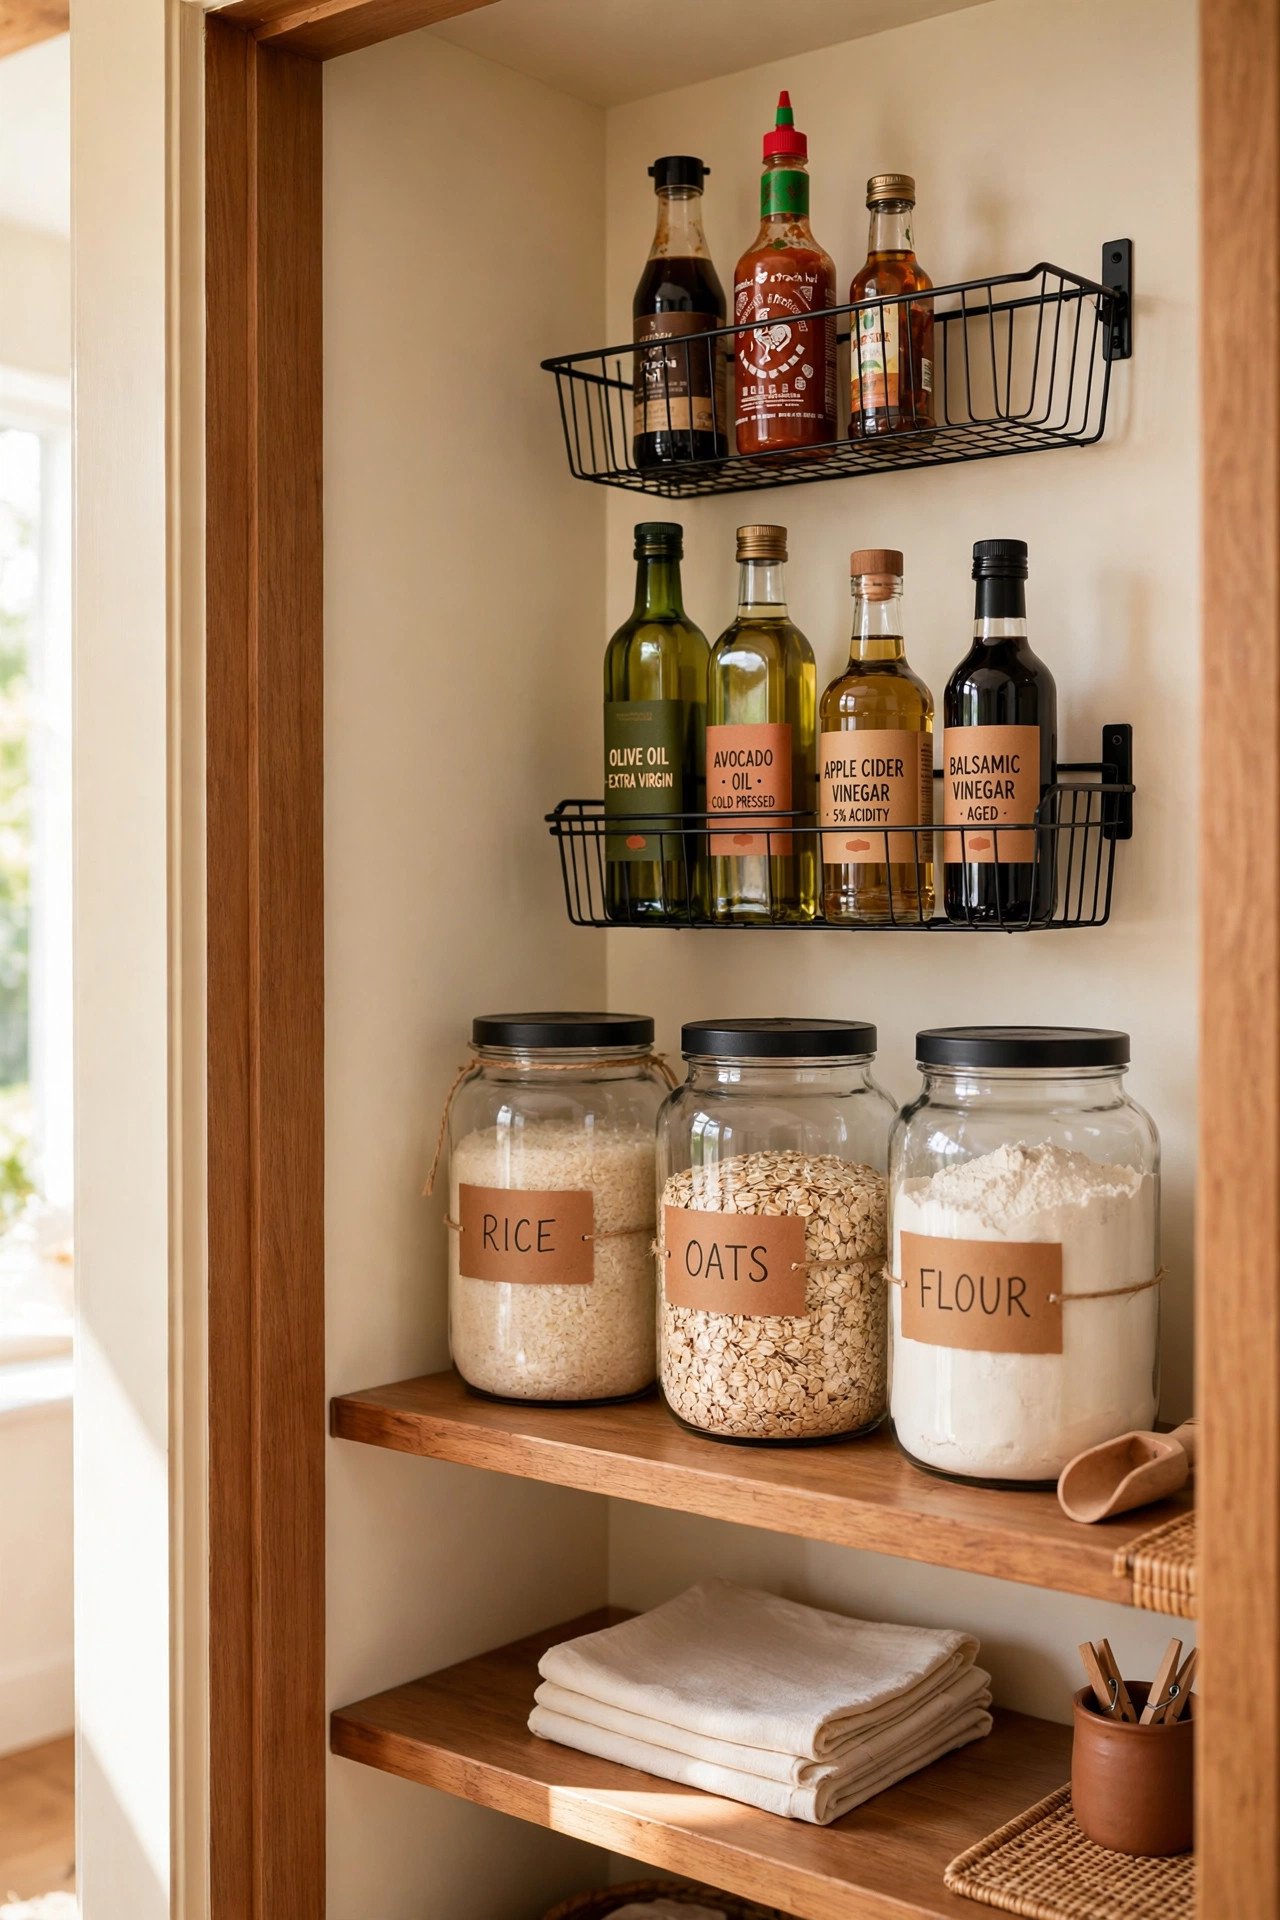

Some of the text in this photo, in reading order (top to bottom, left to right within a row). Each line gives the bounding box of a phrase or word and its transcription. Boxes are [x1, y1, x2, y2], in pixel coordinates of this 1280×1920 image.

[609, 747, 669, 766] OLIVE OIL
[714, 749, 773, 768] AVOCADO
[950, 754, 1020, 775] BALSAMIC
[824, 758, 904, 779] APPLE CIDER
[608, 772, 673, 788] EXTRA VIRGIN
[732, 773, 752, 790] OIL
[832, 784, 890, 802] VINEGAR
[953, 780, 1015, 800] VINEGAR
[711, 795, 775, 809] COLD PRESSED
[833, 808, 890, 823] 5% ACIDITY
[967, 806, 998, 821] AGED
[482, 1213, 557, 1254] RICE
[685, 1239, 769, 1283] OATS
[919, 1268, 1031, 1318] FLOUR
